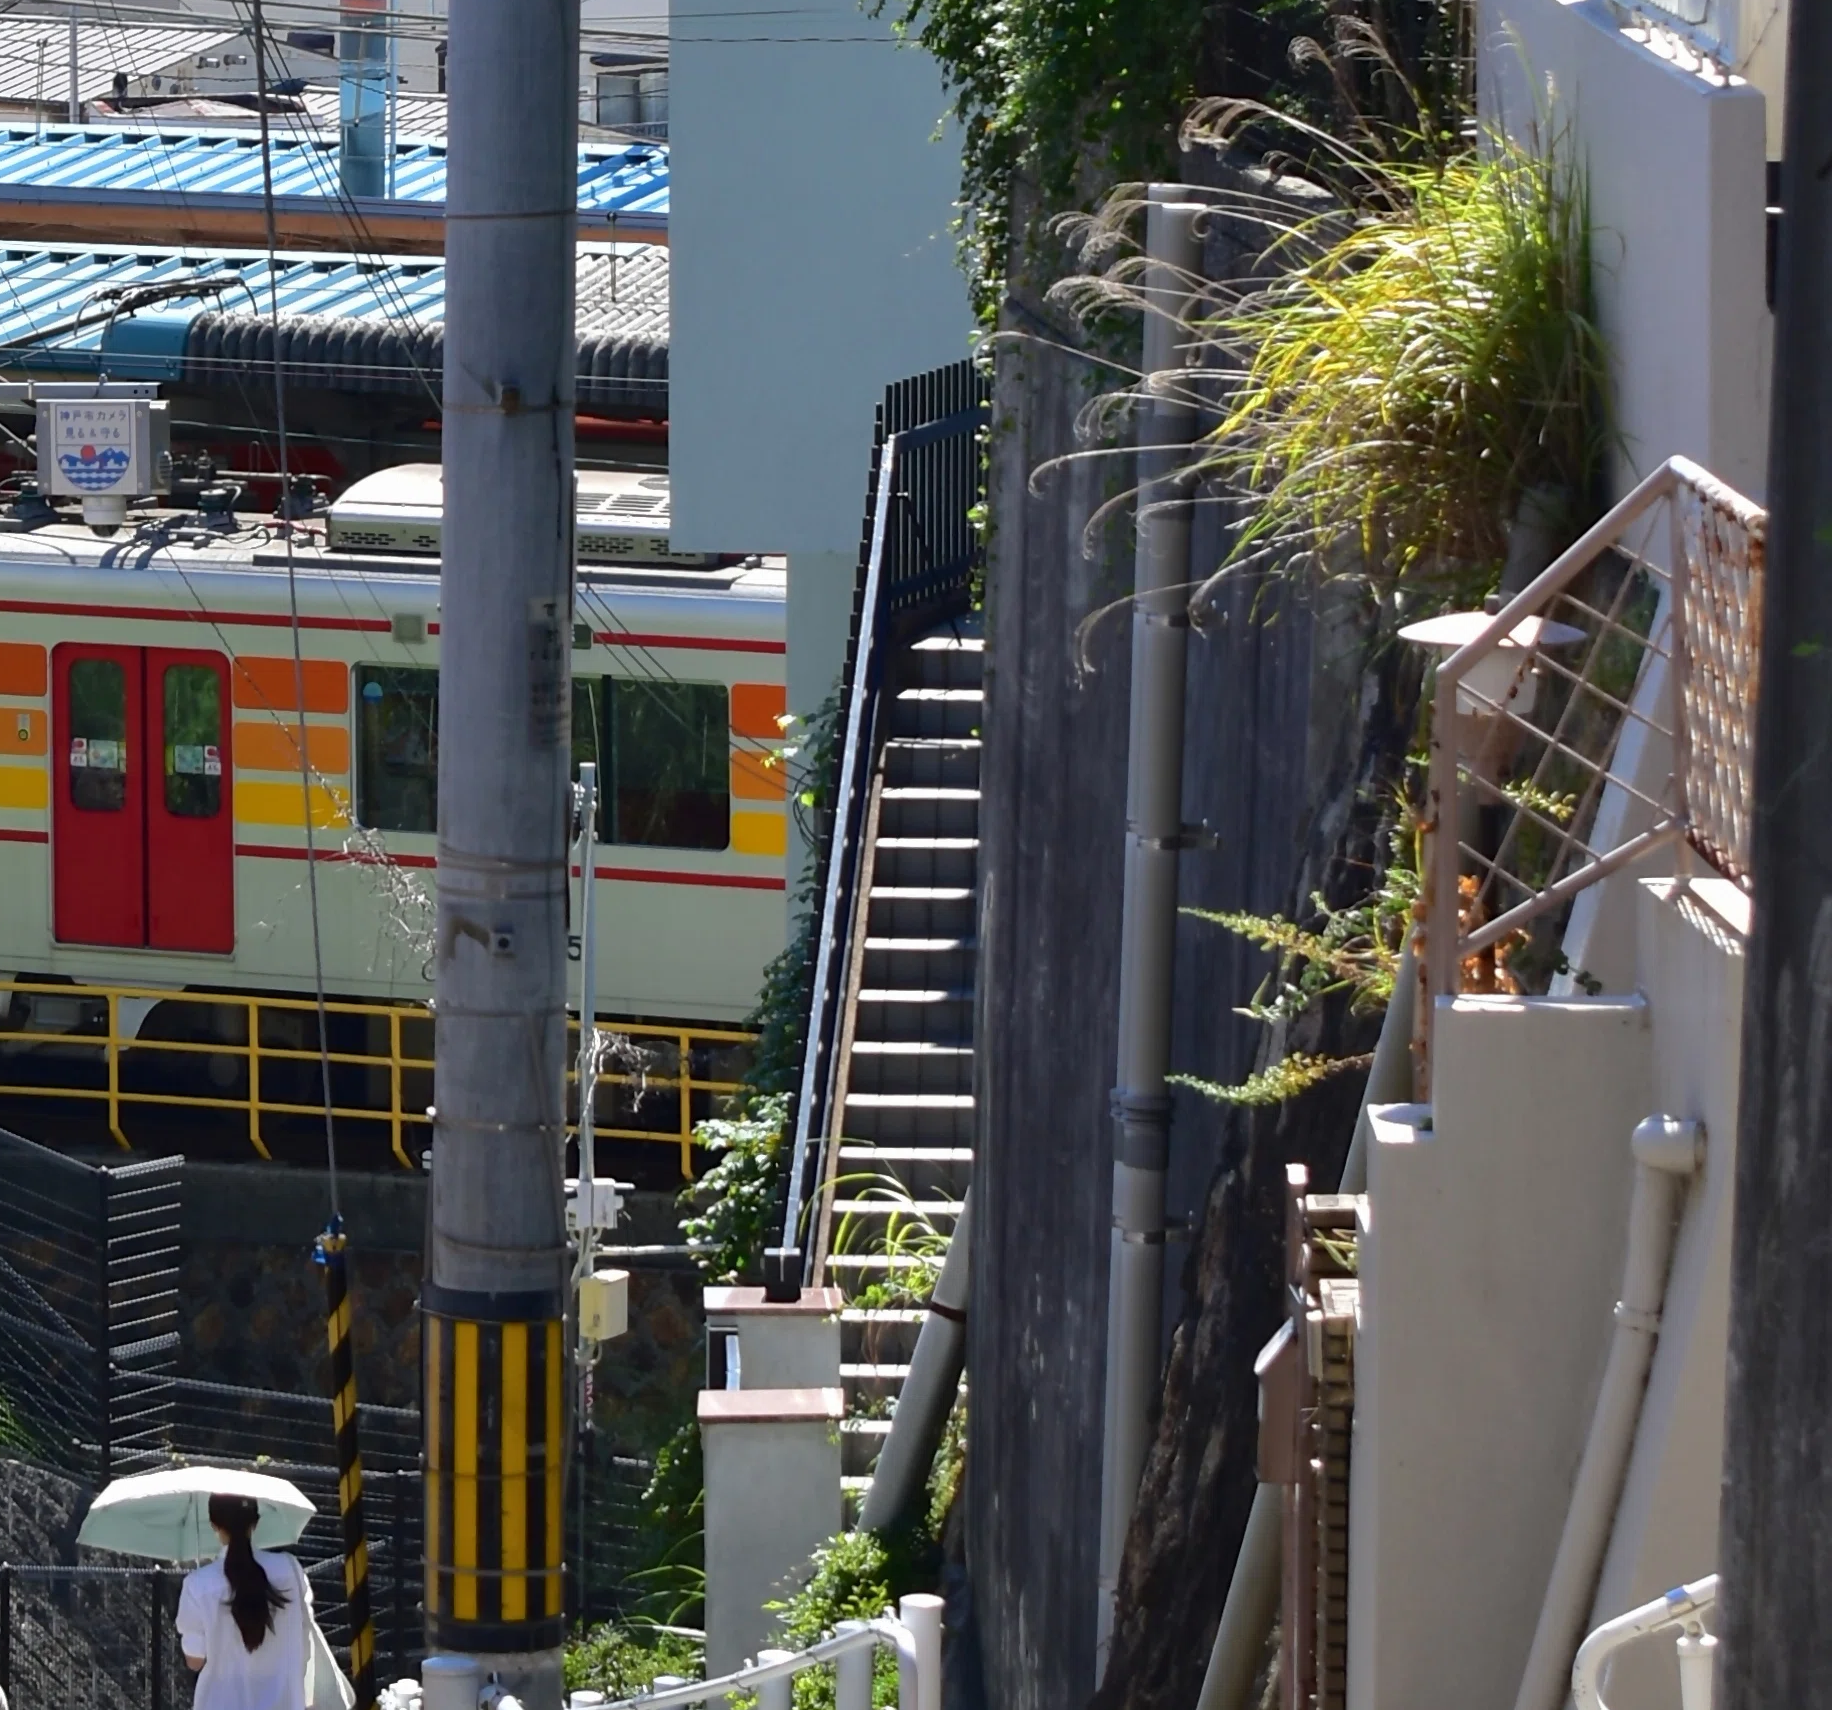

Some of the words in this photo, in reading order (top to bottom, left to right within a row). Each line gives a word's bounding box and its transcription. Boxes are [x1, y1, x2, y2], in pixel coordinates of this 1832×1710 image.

[60, 410, 126, 422] 神戸市カメラ
